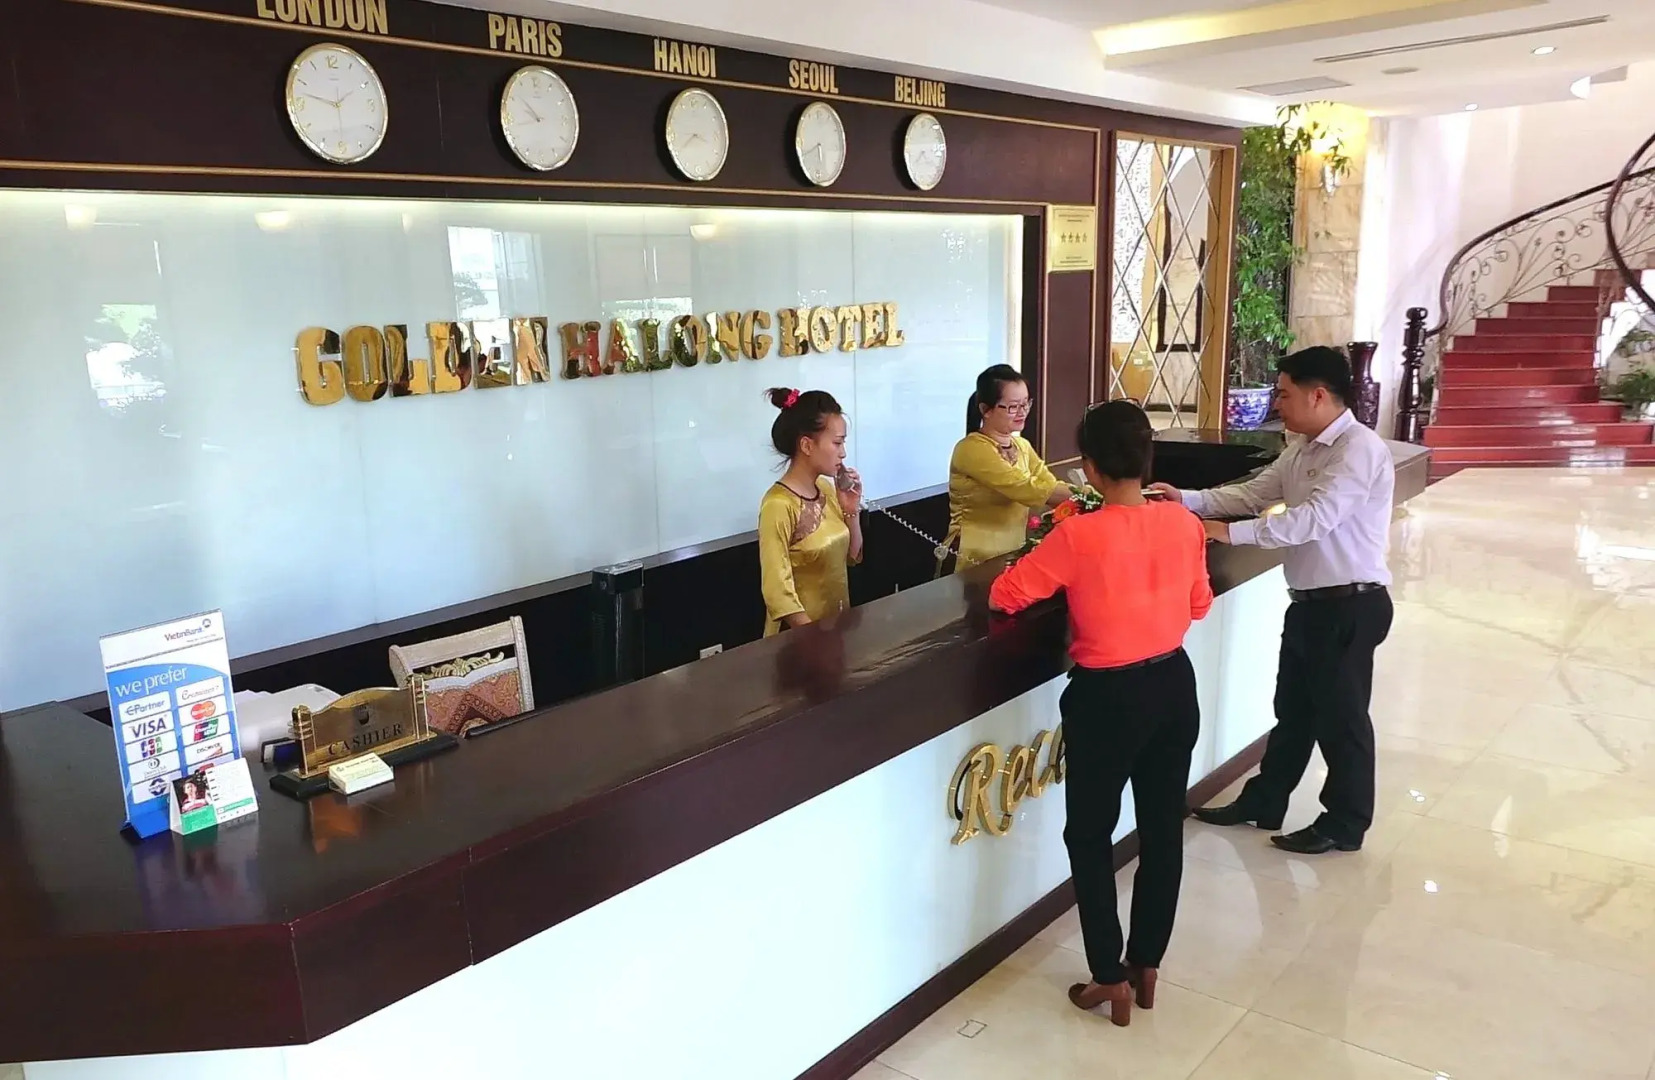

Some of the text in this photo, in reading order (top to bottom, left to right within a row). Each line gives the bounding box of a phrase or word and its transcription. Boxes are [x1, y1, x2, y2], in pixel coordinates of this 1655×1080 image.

[488, 13, 562, 57] PARIS
[654, 39, 716, 78] HANOI
[788, 58, 839, 94] SEOUL
[895, 75, 946, 107] BEIJING
[295, 301, 905, 406] GOLDEN HALONG HOTEL
[115, 680, 142, 697] we
[144, 665, 188, 694] prefer
[129, 717, 167, 738] VISA
[328, 723, 402, 756] CASHIER
